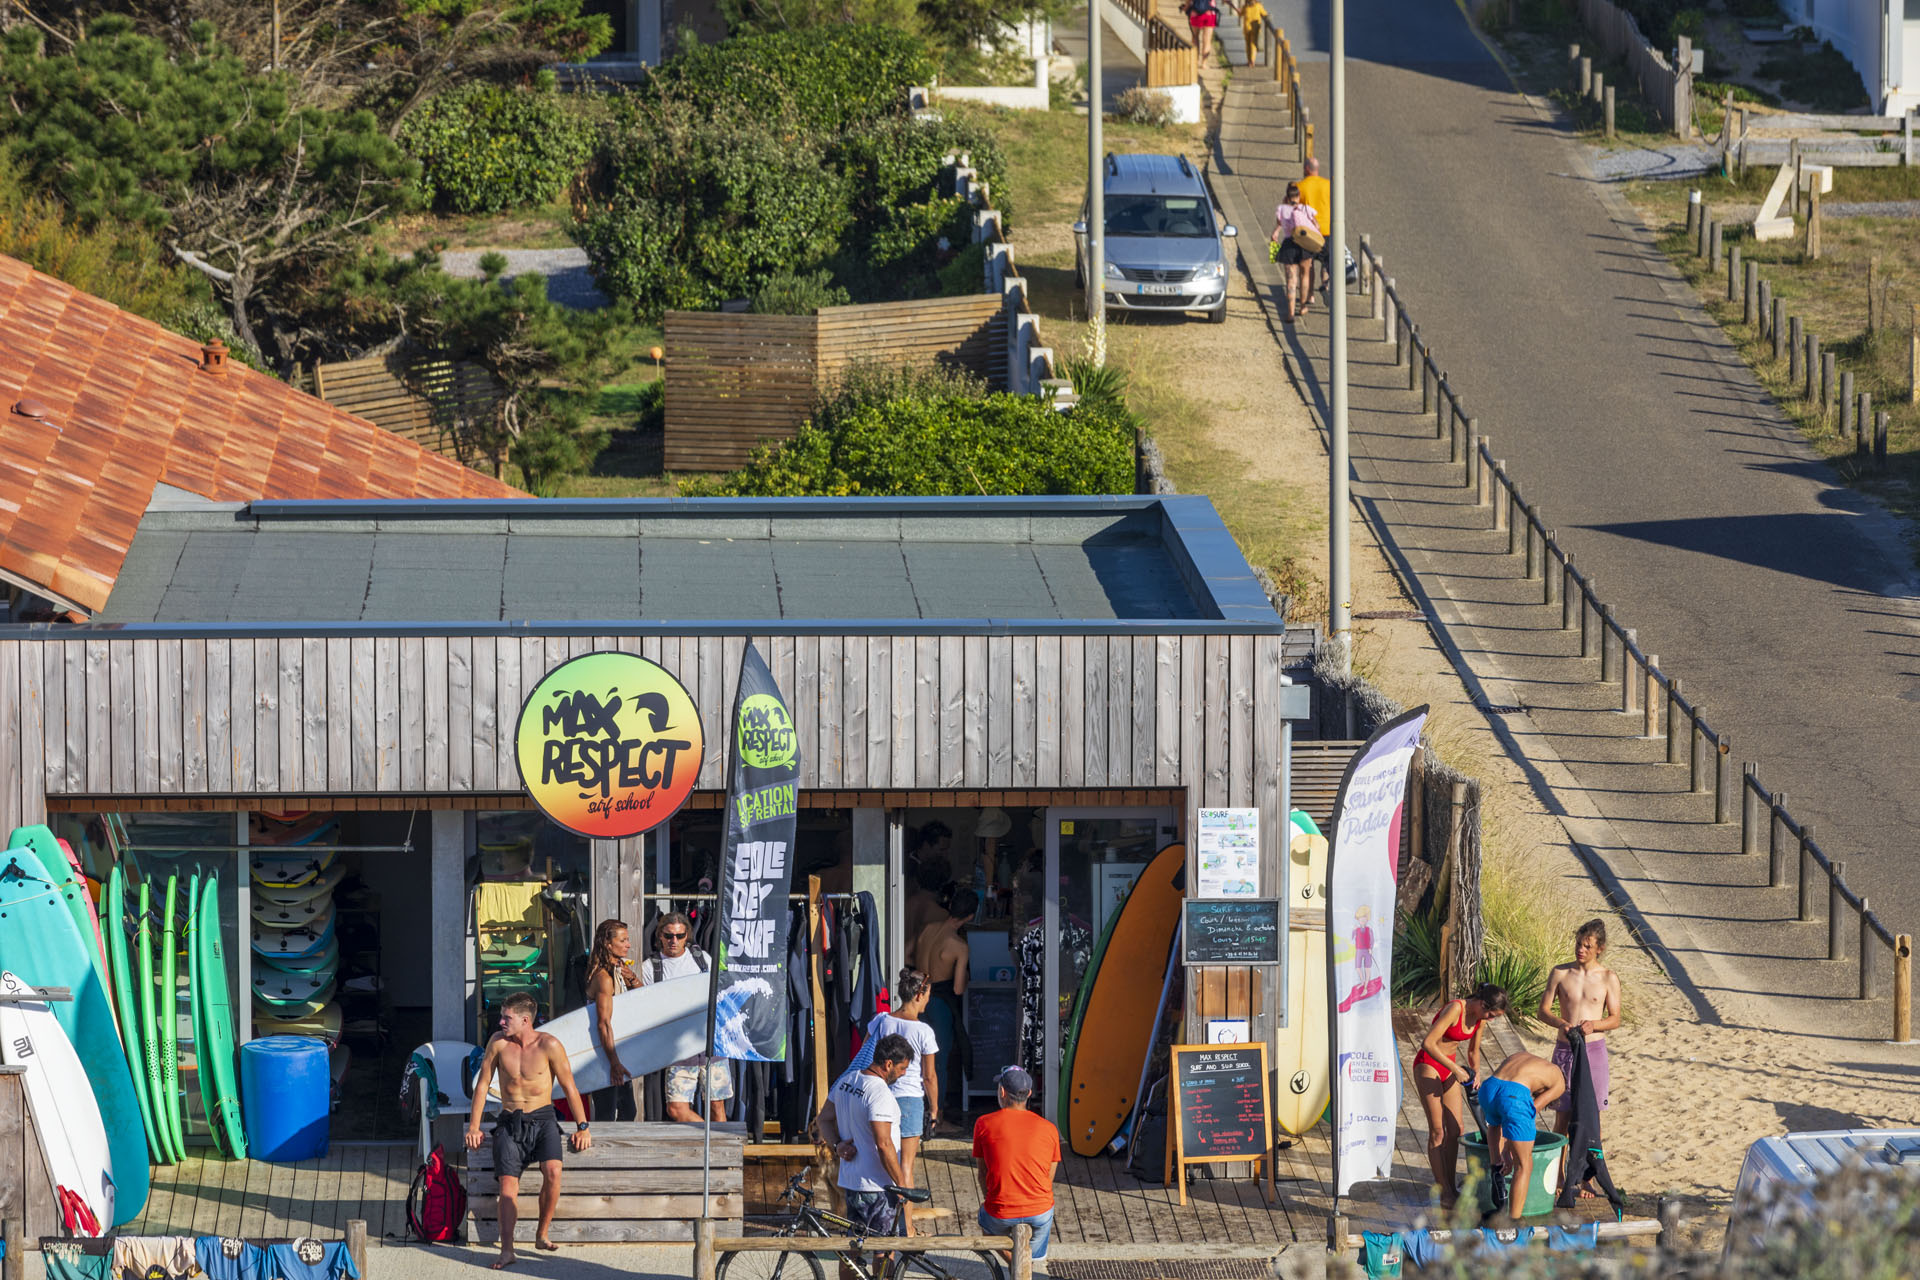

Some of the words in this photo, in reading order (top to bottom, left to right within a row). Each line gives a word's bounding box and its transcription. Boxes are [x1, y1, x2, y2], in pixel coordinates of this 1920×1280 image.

[543, 690, 622, 740] MAX
[743, 706, 770, 728] MAX
[742, 728, 793, 756] RESPECT
[541, 738, 691, 798] RESPECT
[588, 796, 613, 819] surf
[614, 791, 655, 812] school
[736, 784, 794, 817] LCATION
[756, 802, 797, 820] RENTAL
[1215, 1053, 1238, 1061] RESPECT
[1351, 1051, 1374, 1060] COLE
[839, 1082, 865, 1099] STAFF
[1357, 1115, 1388, 1123] DACIA
